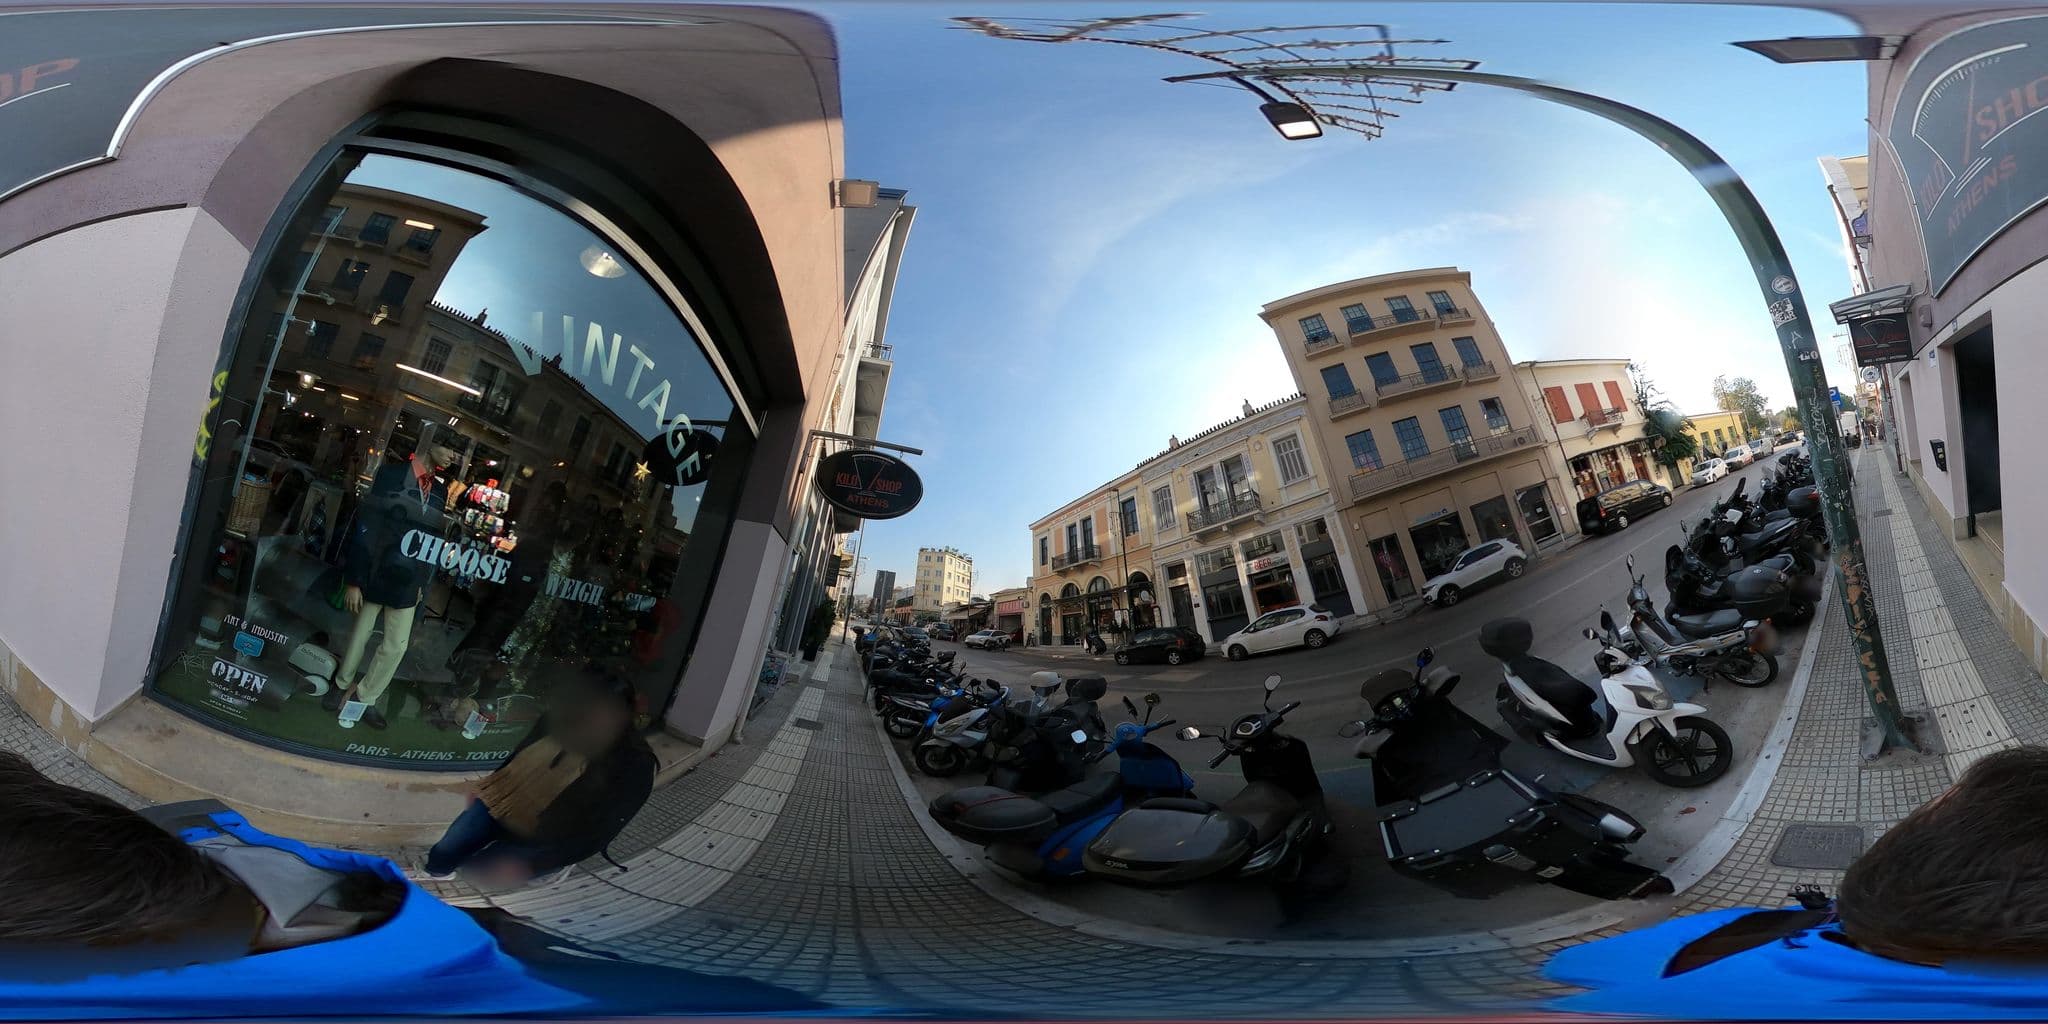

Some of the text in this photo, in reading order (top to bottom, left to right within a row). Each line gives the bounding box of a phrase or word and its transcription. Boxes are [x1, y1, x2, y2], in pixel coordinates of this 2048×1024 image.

[1947, 154, 2017, 236] ATHENS
[506, 311, 699, 486] VINTAGE
[836, 472, 903, 494] KILO SHOP
[847, 495, 889, 508] ATHENS
[400, 529, 512, 585] CHOOSE
[545, 574, 604, 606] WEIGH
[224, 614, 241, 628] ART
[251, 624, 289, 645] INDUSTRY
[211, 661, 268, 694] OPEN
[345, 743, 390, 757] PARIS
[400, 750, 454, 761] ATHENS
[465, 750, 510, 761] TOKYO
